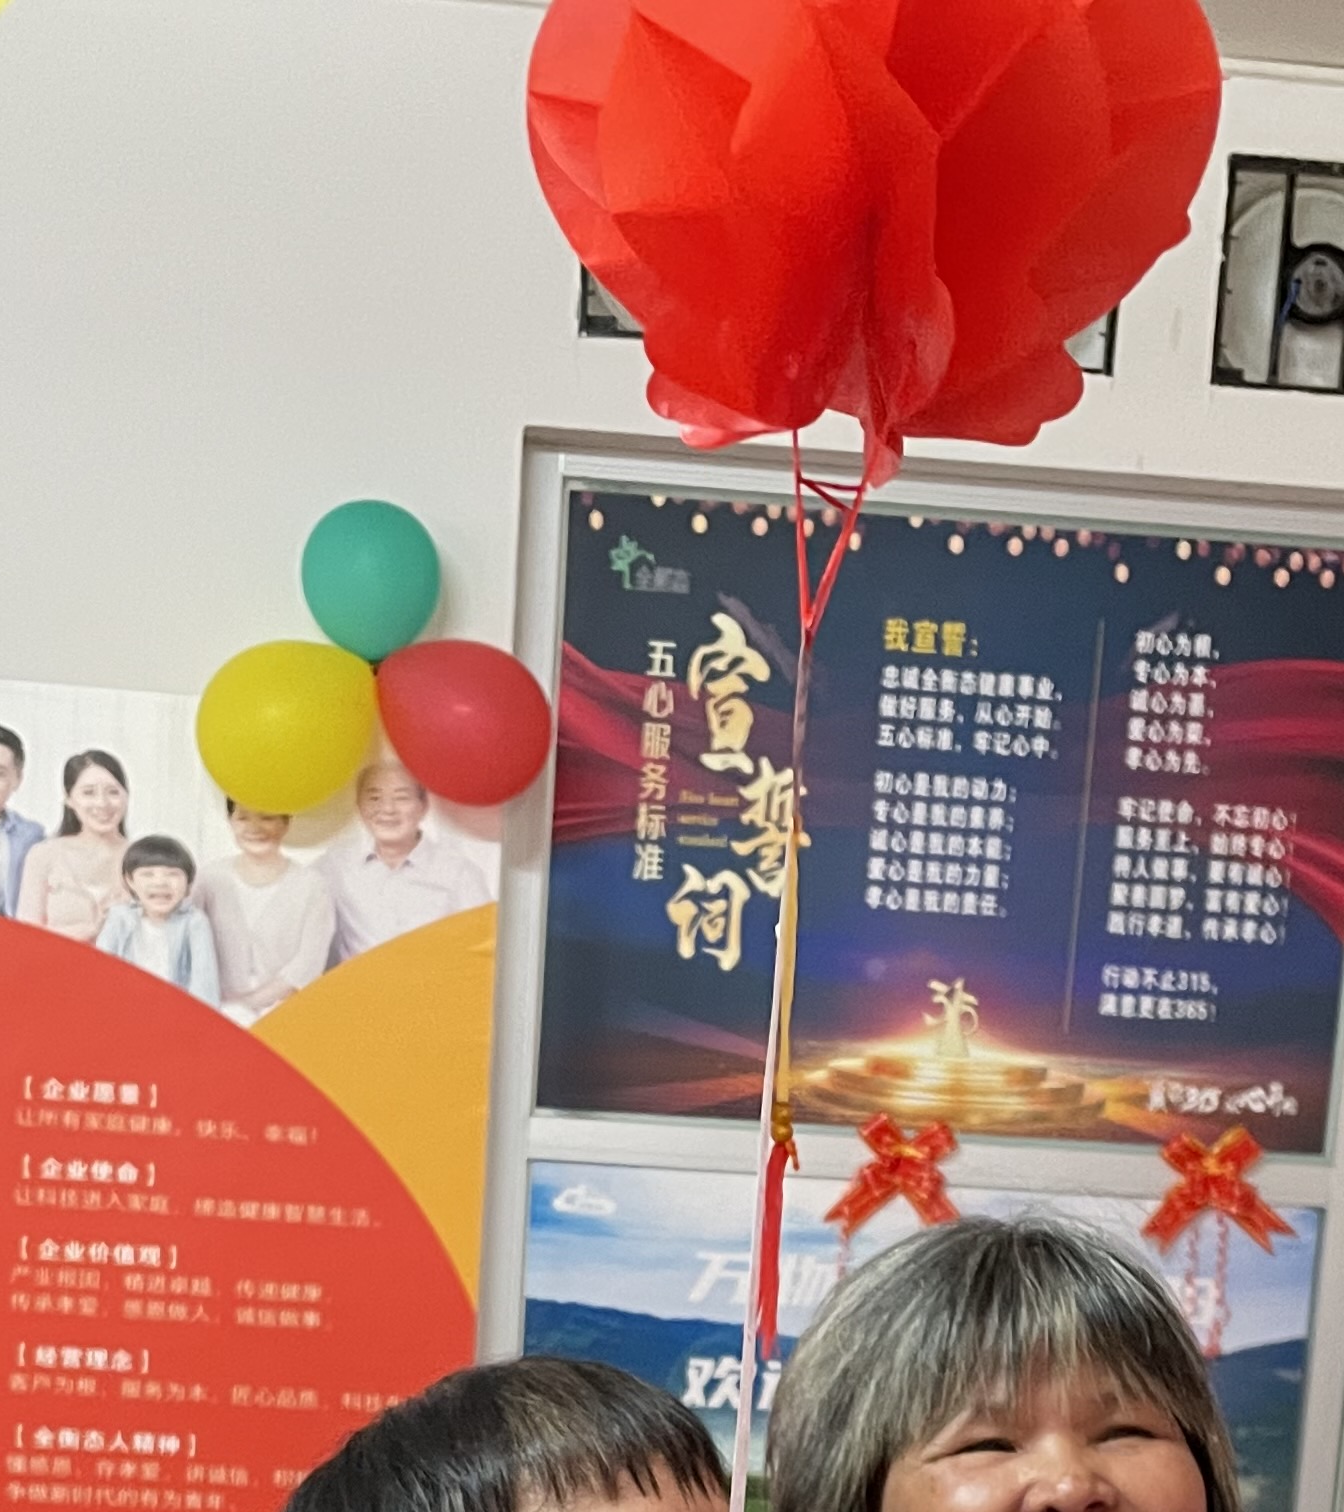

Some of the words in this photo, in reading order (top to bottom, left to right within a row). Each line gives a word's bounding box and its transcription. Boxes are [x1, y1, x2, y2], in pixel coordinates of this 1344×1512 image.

[632, 639, 677, 880] 五心服务标准
